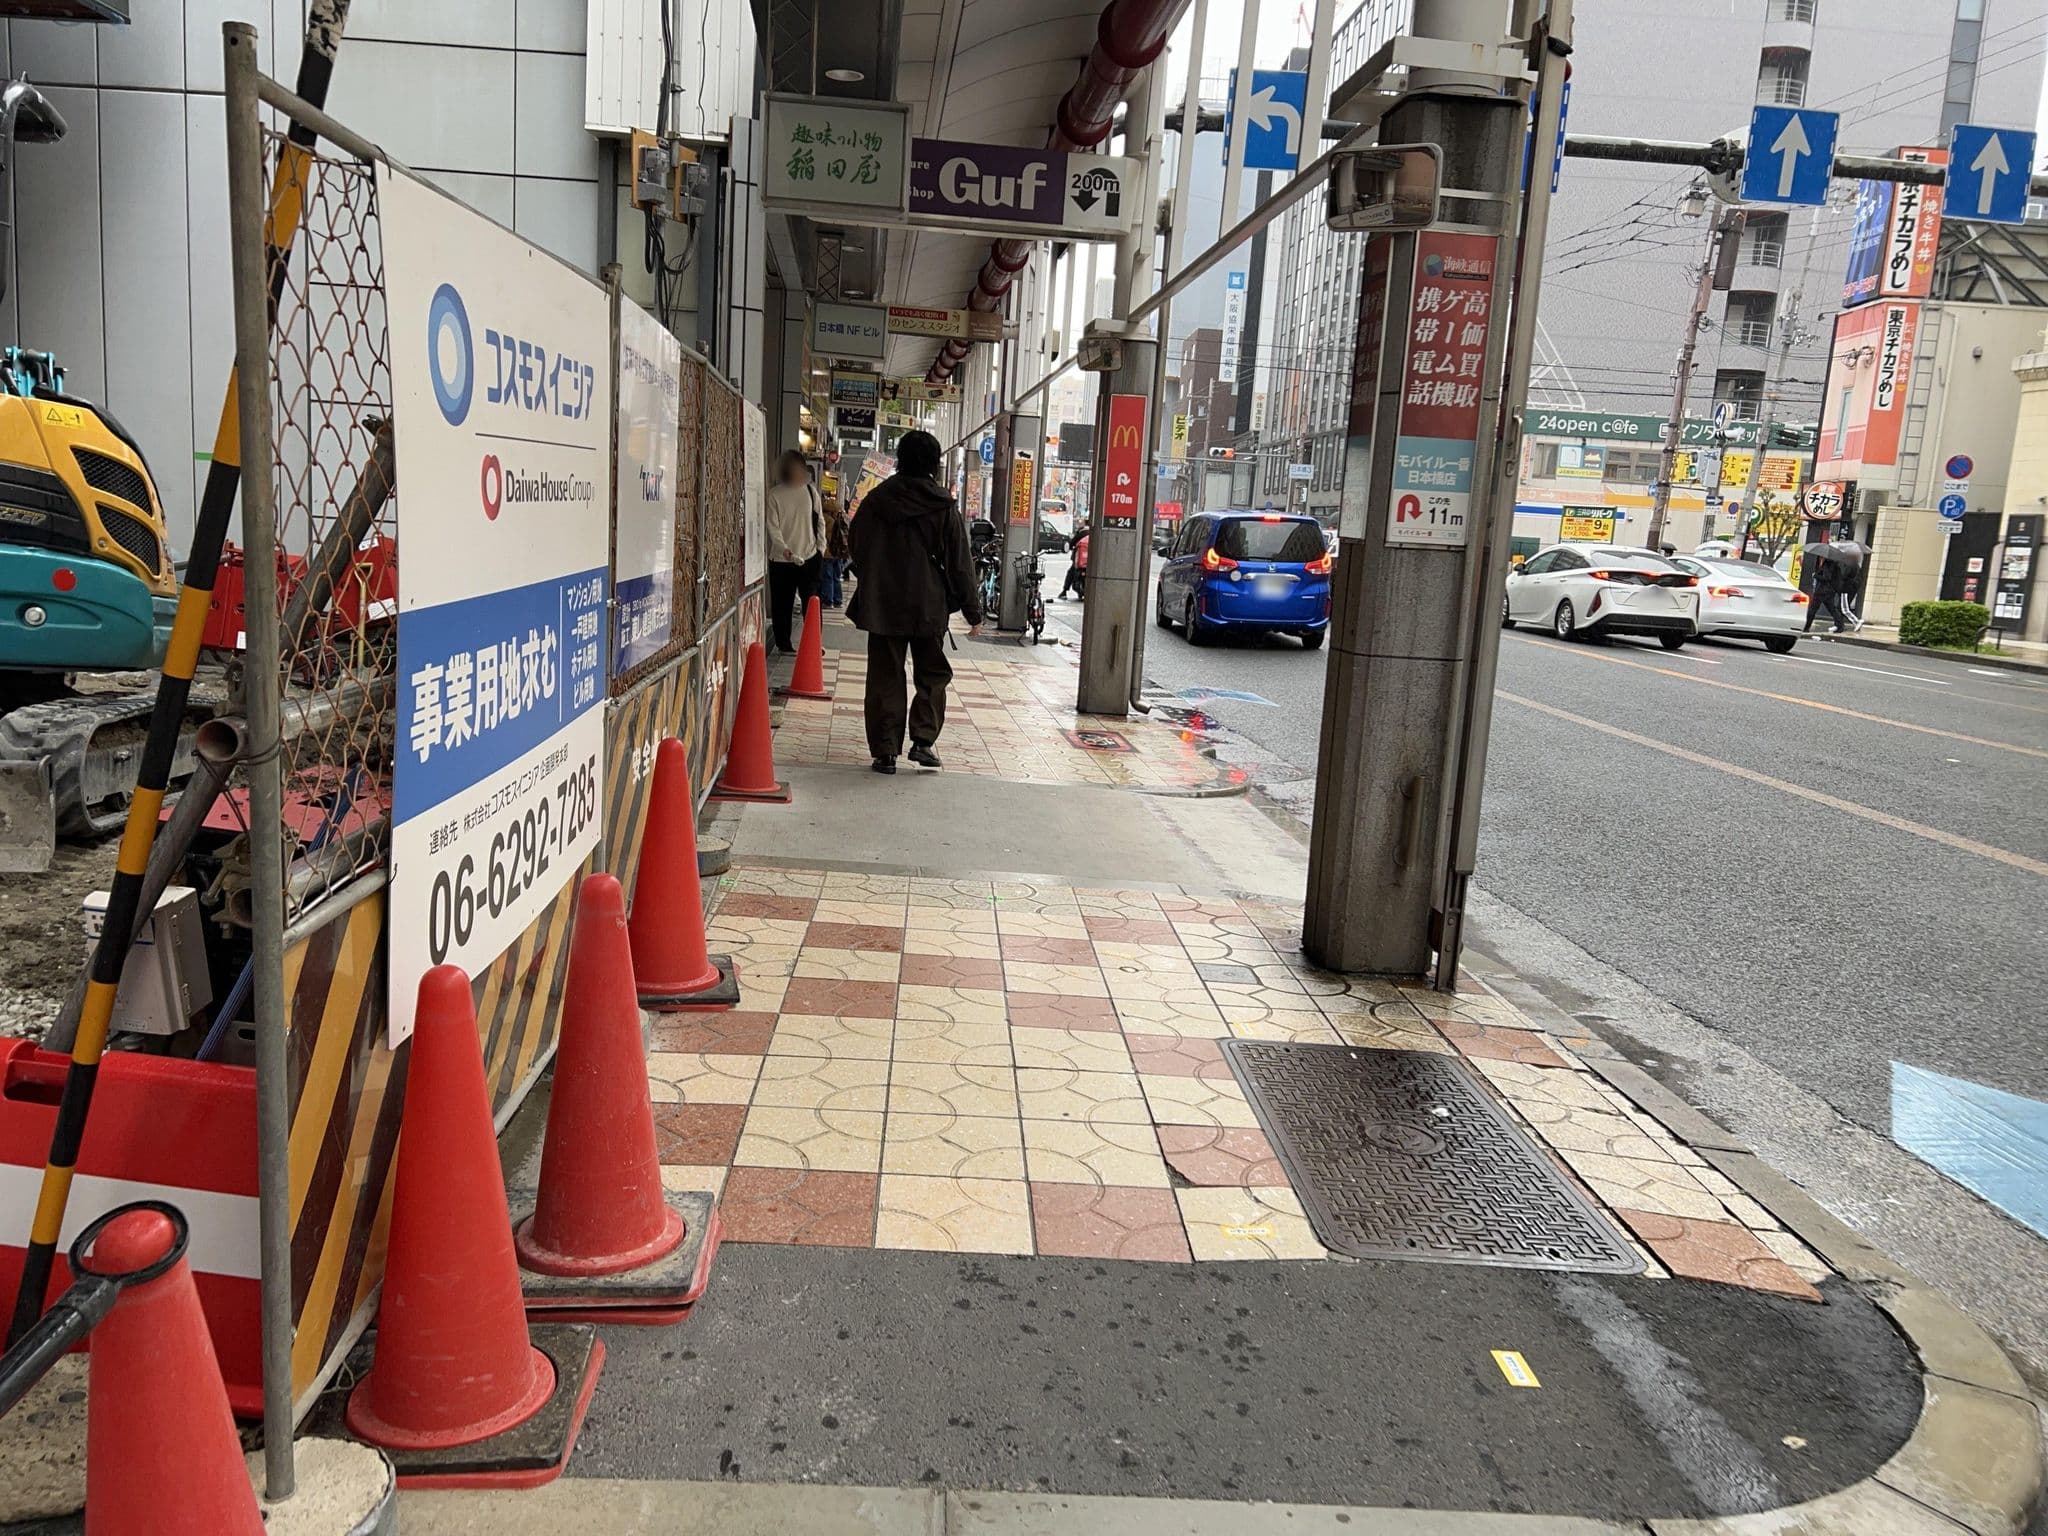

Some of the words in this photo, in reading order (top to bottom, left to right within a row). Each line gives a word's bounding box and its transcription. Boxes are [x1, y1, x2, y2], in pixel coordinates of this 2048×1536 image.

[791, 121, 882, 152] 趣味の小物
[939, 156, 1048, 210] Guf
[1071, 173, 1120, 194] 200m
[818, 322, 845, 335] 日本橋
[846, 326, 860, 336] NF
[863, 327, 880, 338] ビル
[1407, 286, 1443, 406] 携帯電話
[1431, 287, 1467, 407] ゲーム機
[1454, 290, 1490, 408] 高価買取
[1878, 309, 1905, 408] 東京チカラめし
[485, 327, 594, 422] コスモスイニシア
[1538, 415, 1597, 433] 24open
[1601, 418, 1639, 435] c@fe
[1398, 455, 1470, 471] モバイル一番
[1407, 470, 1457, 486] 日本橋店
[505, 468, 539, 503] Daiwa
[540, 471, 568, 502] House
[1111, 493, 1133, 505] 170m
[1809, 493, 1841, 506] チカラ
[1429, 507, 1464, 526] 11m
[1812, 505, 1831, 515] めし
[410, 624, 558, 764] 事業用地求む
[429, 818, 458, 856] 連絡先
[463, 764, 540, 834] 株式会社コスモスイニシア
[429, 753, 596, 967] 06-6292-7285
